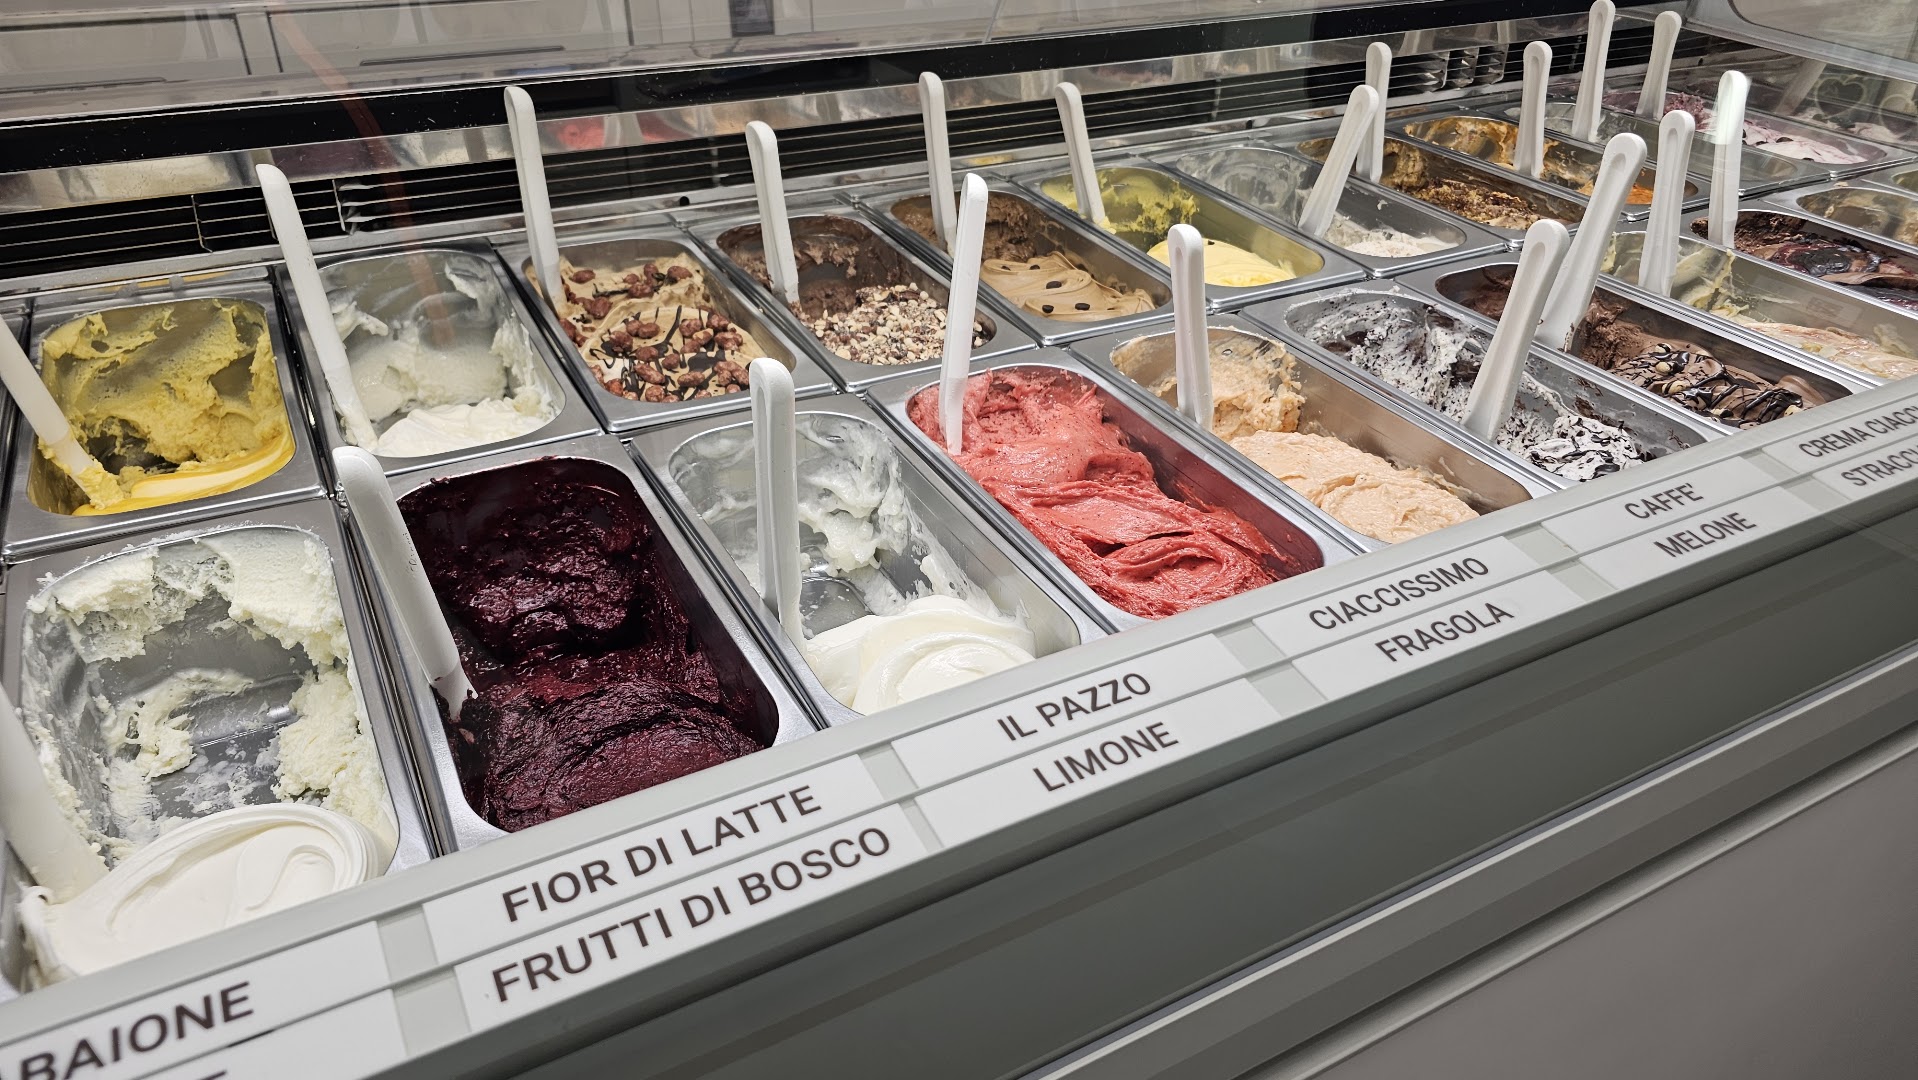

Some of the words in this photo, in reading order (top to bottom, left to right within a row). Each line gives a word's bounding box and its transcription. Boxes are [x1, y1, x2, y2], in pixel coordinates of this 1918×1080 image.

[1798, 426, 1876, 458] CREMA
[1624, 482, 1704, 519] CAFFE'
[1653, 512, 1757, 558] MELONE
[1309, 557, 1489, 630] CIACCISSIMO
[1374, 602, 1515, 662] FRAGOLA
[997, 715, 1038, 741] IL
[1035, 673, 1151, 728] PAZZO
[1033, 721, 1179, 792] LIMONE
[502, 859, 617, 922] FIOR
[624, 837, 673, 877] DI
[681, 785, 822, 856] LATTE
[492, 907, 672, 1002] FRUTTI
[680, 886, 732, 928] DI
[738, 827, 890, 905] BOSCO
[0, 981, 254, 1080] BAIONE
